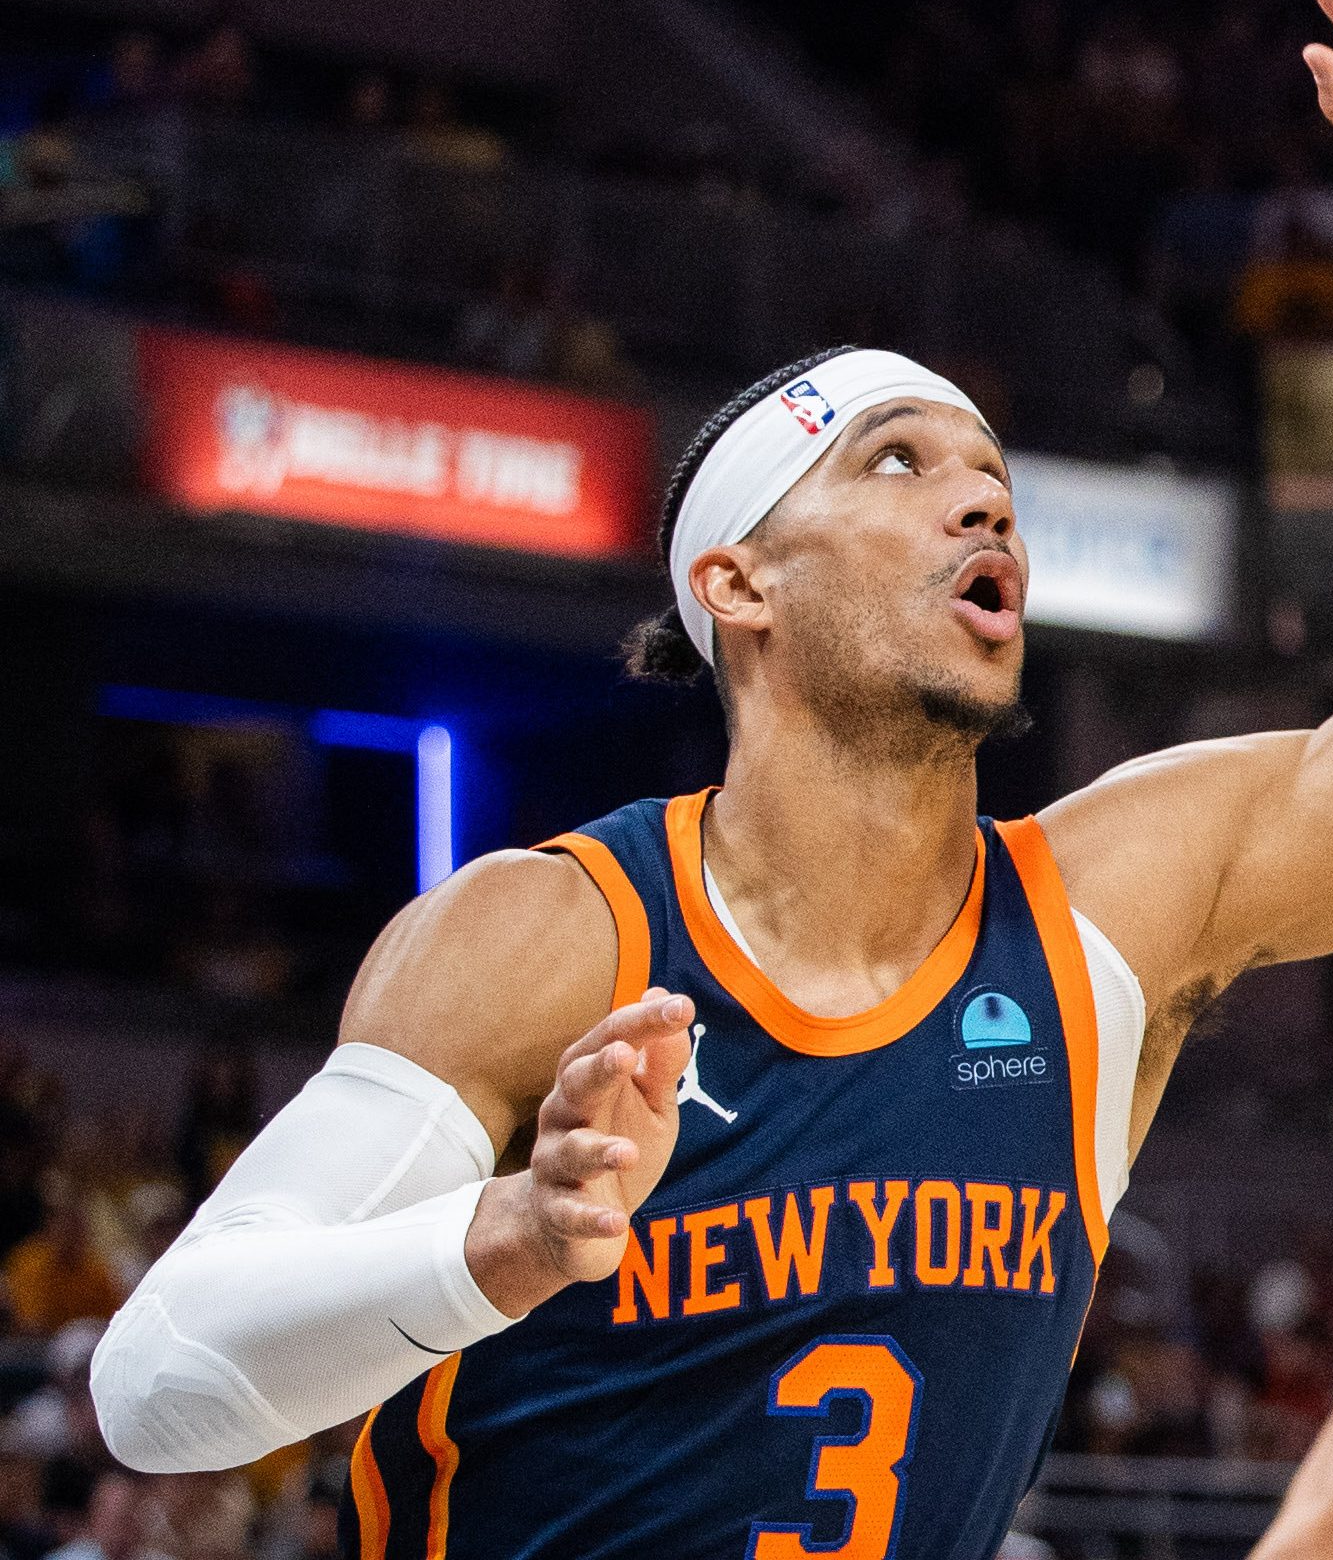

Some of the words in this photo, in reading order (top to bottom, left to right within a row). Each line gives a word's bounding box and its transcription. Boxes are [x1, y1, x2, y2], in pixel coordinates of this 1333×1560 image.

[957, 1055, 1046, 1086] sphere
[612, 1184, 837, 1327] NEW
[844, 1178, 1069, 1296] YORK
[744, 1334, 926, 1560] 3
